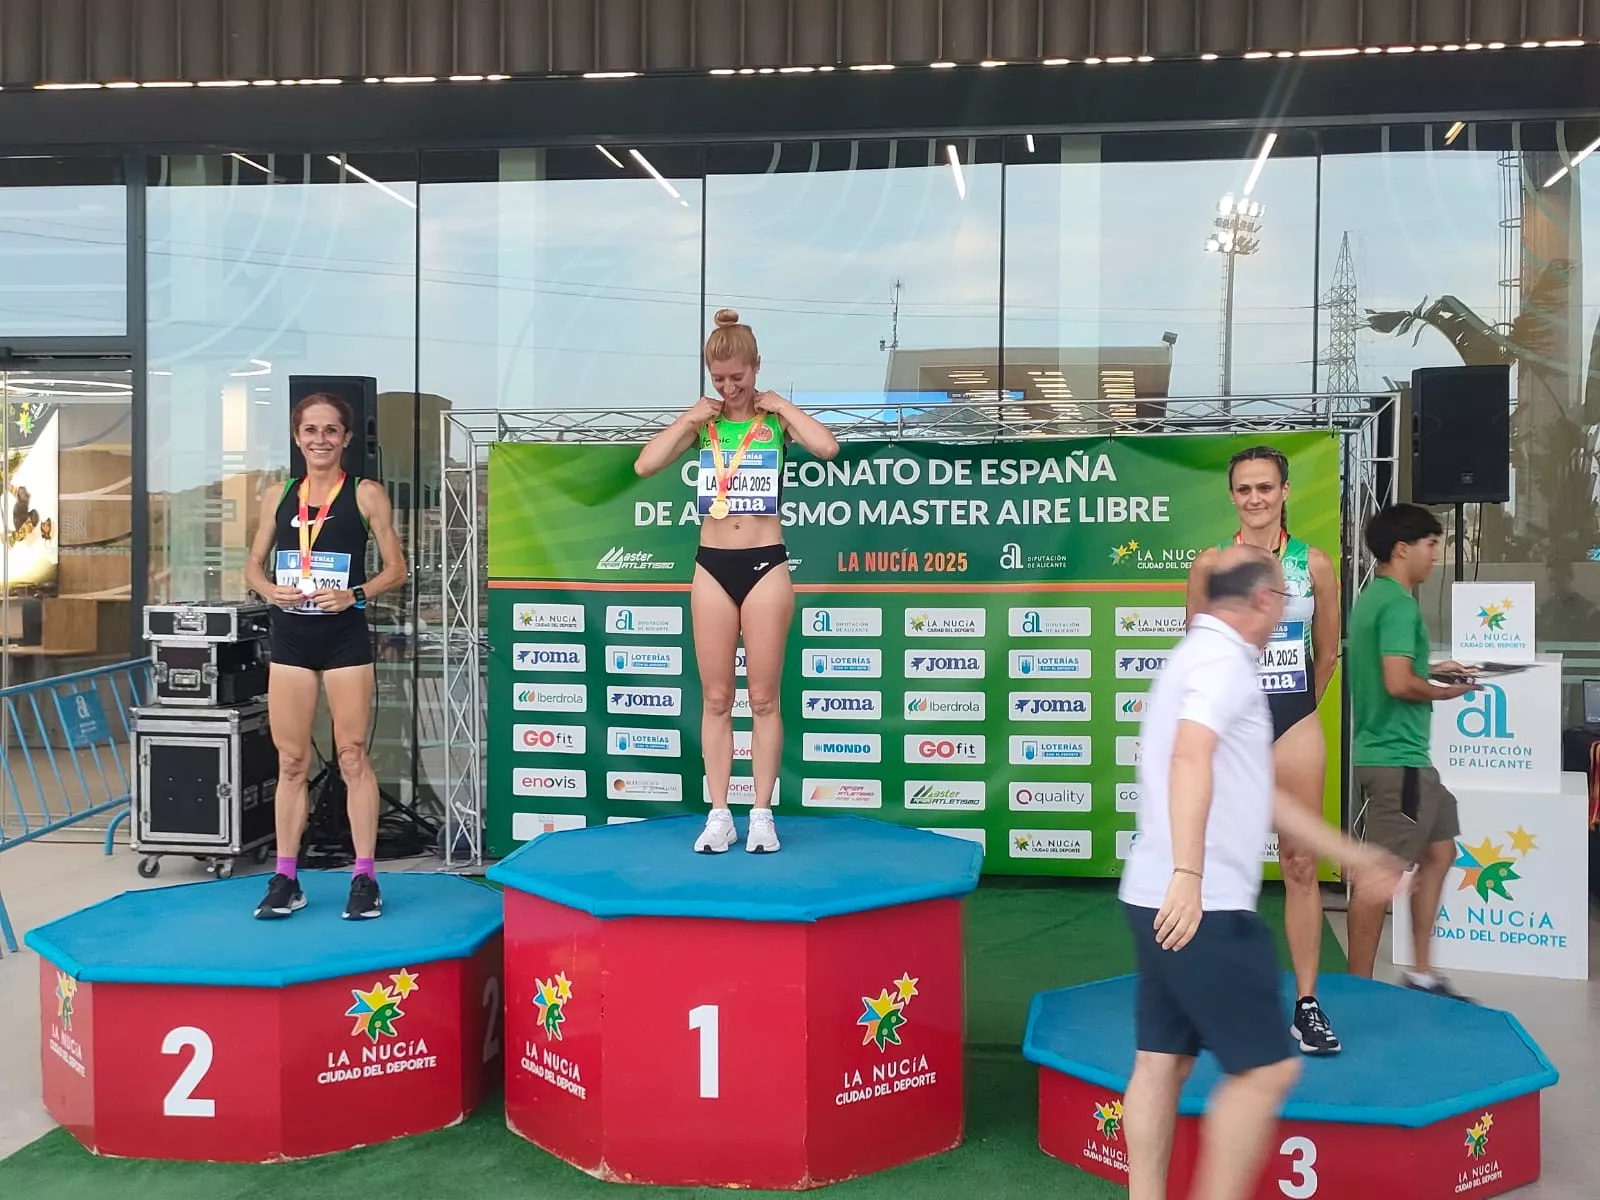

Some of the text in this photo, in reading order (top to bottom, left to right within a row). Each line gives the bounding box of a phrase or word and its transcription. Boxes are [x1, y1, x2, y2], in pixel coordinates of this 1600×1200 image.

[682, 450, 1117, 488] CEONATO DE ESPAÑA
[726, 473, 748, 491] UCÍA
[750, 476, 771, 492] 2025
[635, 502, 676, 526] DE
[859, 500, 989, 526] MASTER
[997, 497, 1071, 525] AIRE
[1080, 496, 1170, 523] LIBRE
[838, 548, 967, 572] LA NUCÍA 2025
[1137, 549, 1200, 561] LA NUC
[1138, 619, 1149, 627] LA
[1465, 633, 1477, 641] LA
[631, 653, 671, 661] LOTERÍAS
[830, 655, 871, 664] LOTERÍAS
[1037, 655, 1079, 665] LOTERÍAS
[1276, 648, 1298, 666] 2025
[536, 691, 583, 704] Iberdrola
[929, 700, 980, 712] Iberdrola
[632, 735, 669, 744] LOTERÍAS
[1041, 742, 1083, 751] LOTERÍAS
[823, 743, 871, 754] MONDO
[1449, 743, 1532, 757] DIPUTACIÓN
[1449, 757, 1532, 770] DE ALICANTE
[522, 775, 576, 789] enovis
[1034, 789, 1085, 805] quality
[1436, 904, 1450, 922] A
[1470, 929, 1496, 943] DEL
[1500, 931, 1567, 948] DEPORTE
[328, 1049, 351, 1068] LA
[526, 1040, 538, 1060] LA
[688, 1004, 719, 1099] 1
[160, 1026, 215, 1117] 2
[317, 1056, 437, 1084] CIUDAD DEL DEPORTE
[521, 1056, 587, 1100] CIUDAD DEL DEPORTE
[844, 1069, 863, 1089] LA
[835, 1072, 937, 1106] CIUDAD DEL DEPORTE
[1087, 1138, 1098, 1152] LA
[1278, 1136, 1318, 1199] 3
[1458, 1171, 1468, 1184] LA
